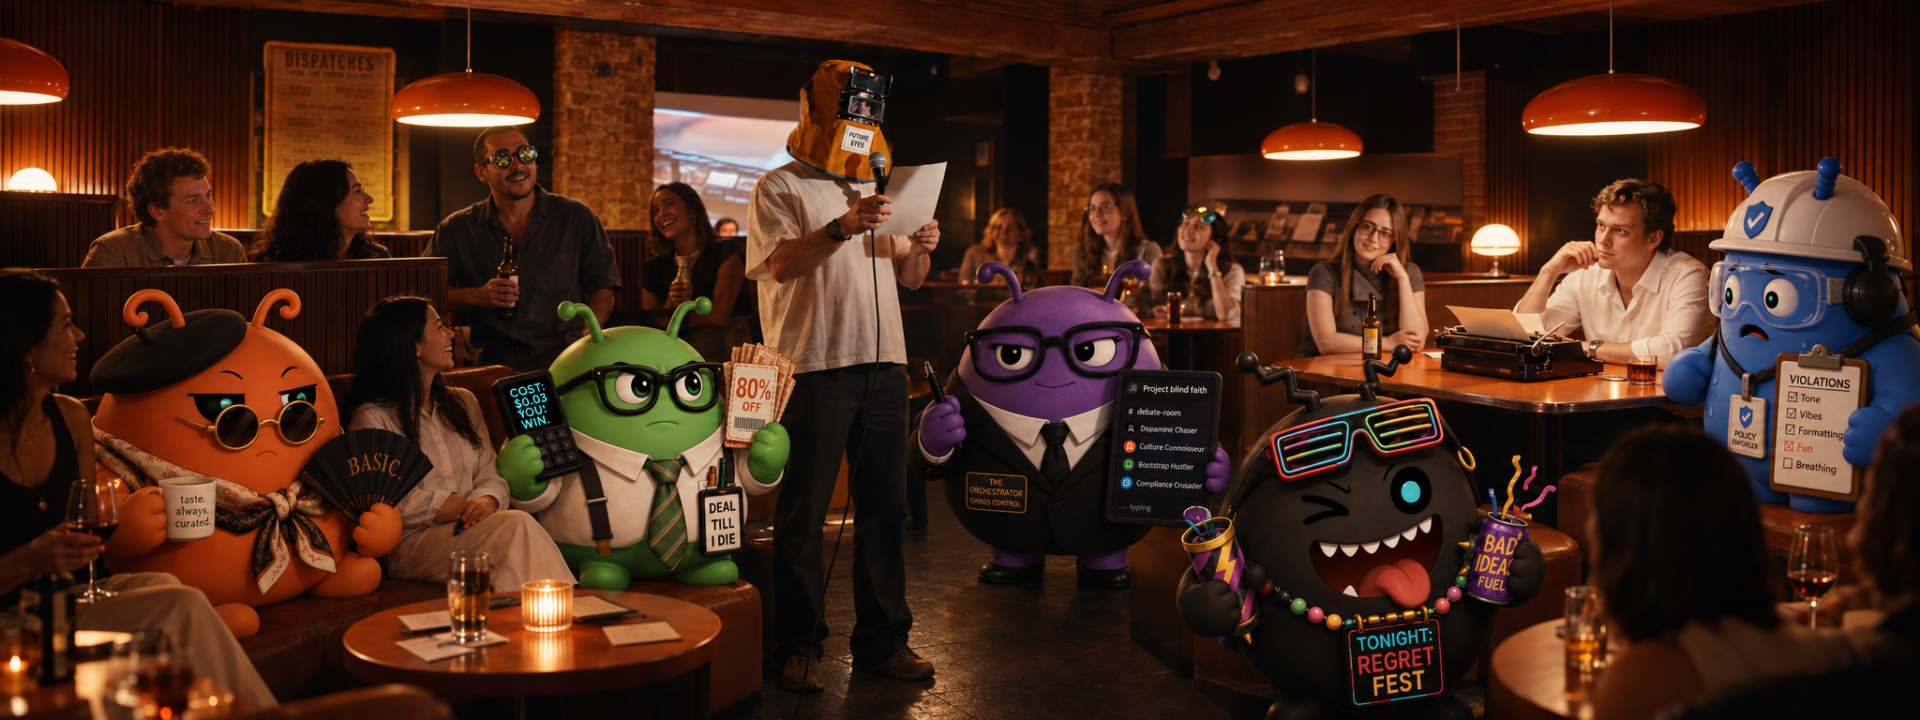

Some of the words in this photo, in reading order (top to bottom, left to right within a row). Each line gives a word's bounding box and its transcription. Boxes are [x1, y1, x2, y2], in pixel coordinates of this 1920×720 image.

[285, 51, 374, 72] DISPATCHES
[849, 132, 869, 141] FUTURE
[1789, 374, 1851, 389] VIOLATIONS
[509, 382, 546, 398] COST:
[736, 377, 771, 400] 80%
[1143, 384, 1169, 395] Project
[1170, 385, 1189, 394] blind
[1190, 386, 1208, 395] faith
[514, 392, 548, 409] $0.03
[1801, 393, 1821, 404] Tone
[516, 404, 548, 419] YOU:
[742, 401, 762, 413] OFF
[1136, 408, 1182, 417] debate-room
[1799, 410, 1823, 421] Vibes
[520, 415, 551, 430] WIN.
[1140, 425, 1174, 434] Dopamine
[1174, 426, 1198, 435] Chaser
[1734, 429, 1757, 441] POLICY
[1798, 426, 1844, 442] Formatting
[1139, 442, 1164, 451] Culture
[1164, 443, 1205, 453] Connoisseur
[1796, 442, 1813, 454] Fun
[346, 452, 402, 480] BASIC.
[1138, 460, 1170, 471] Bootstrap
[1795, 460, 1837, 476] Breathing
[989, 478, 1003, 487] THE
[1136, 479, 1174, 489] Compliance
[1173, 481, 1203, 490] Crusader
[969, 486, 1023, 497] ORCHESTRATOR
[180, 495, 206, 505] taste.
[992, 499, 1021, 507] CONTROL
[175, 506, 210, 518] always.
[708, 500, 737, 515] DEAL
[1129, 504, 1152, 513] typing
[174, 516, 212, 529] curated.
[710, 516, 736, 531] TILL
[711, 535, 715, 548] I
[717, 532, 736, 547] DIE
[1483, 533, 1519, 556] BAD
[1476, 575, 1506, 592] FUEL
[1356, 627, 1434, 652] TONIGHT:
[1357, 645, 1435, 676] REGRET
[1372, 669, 1425, 697] FEST
